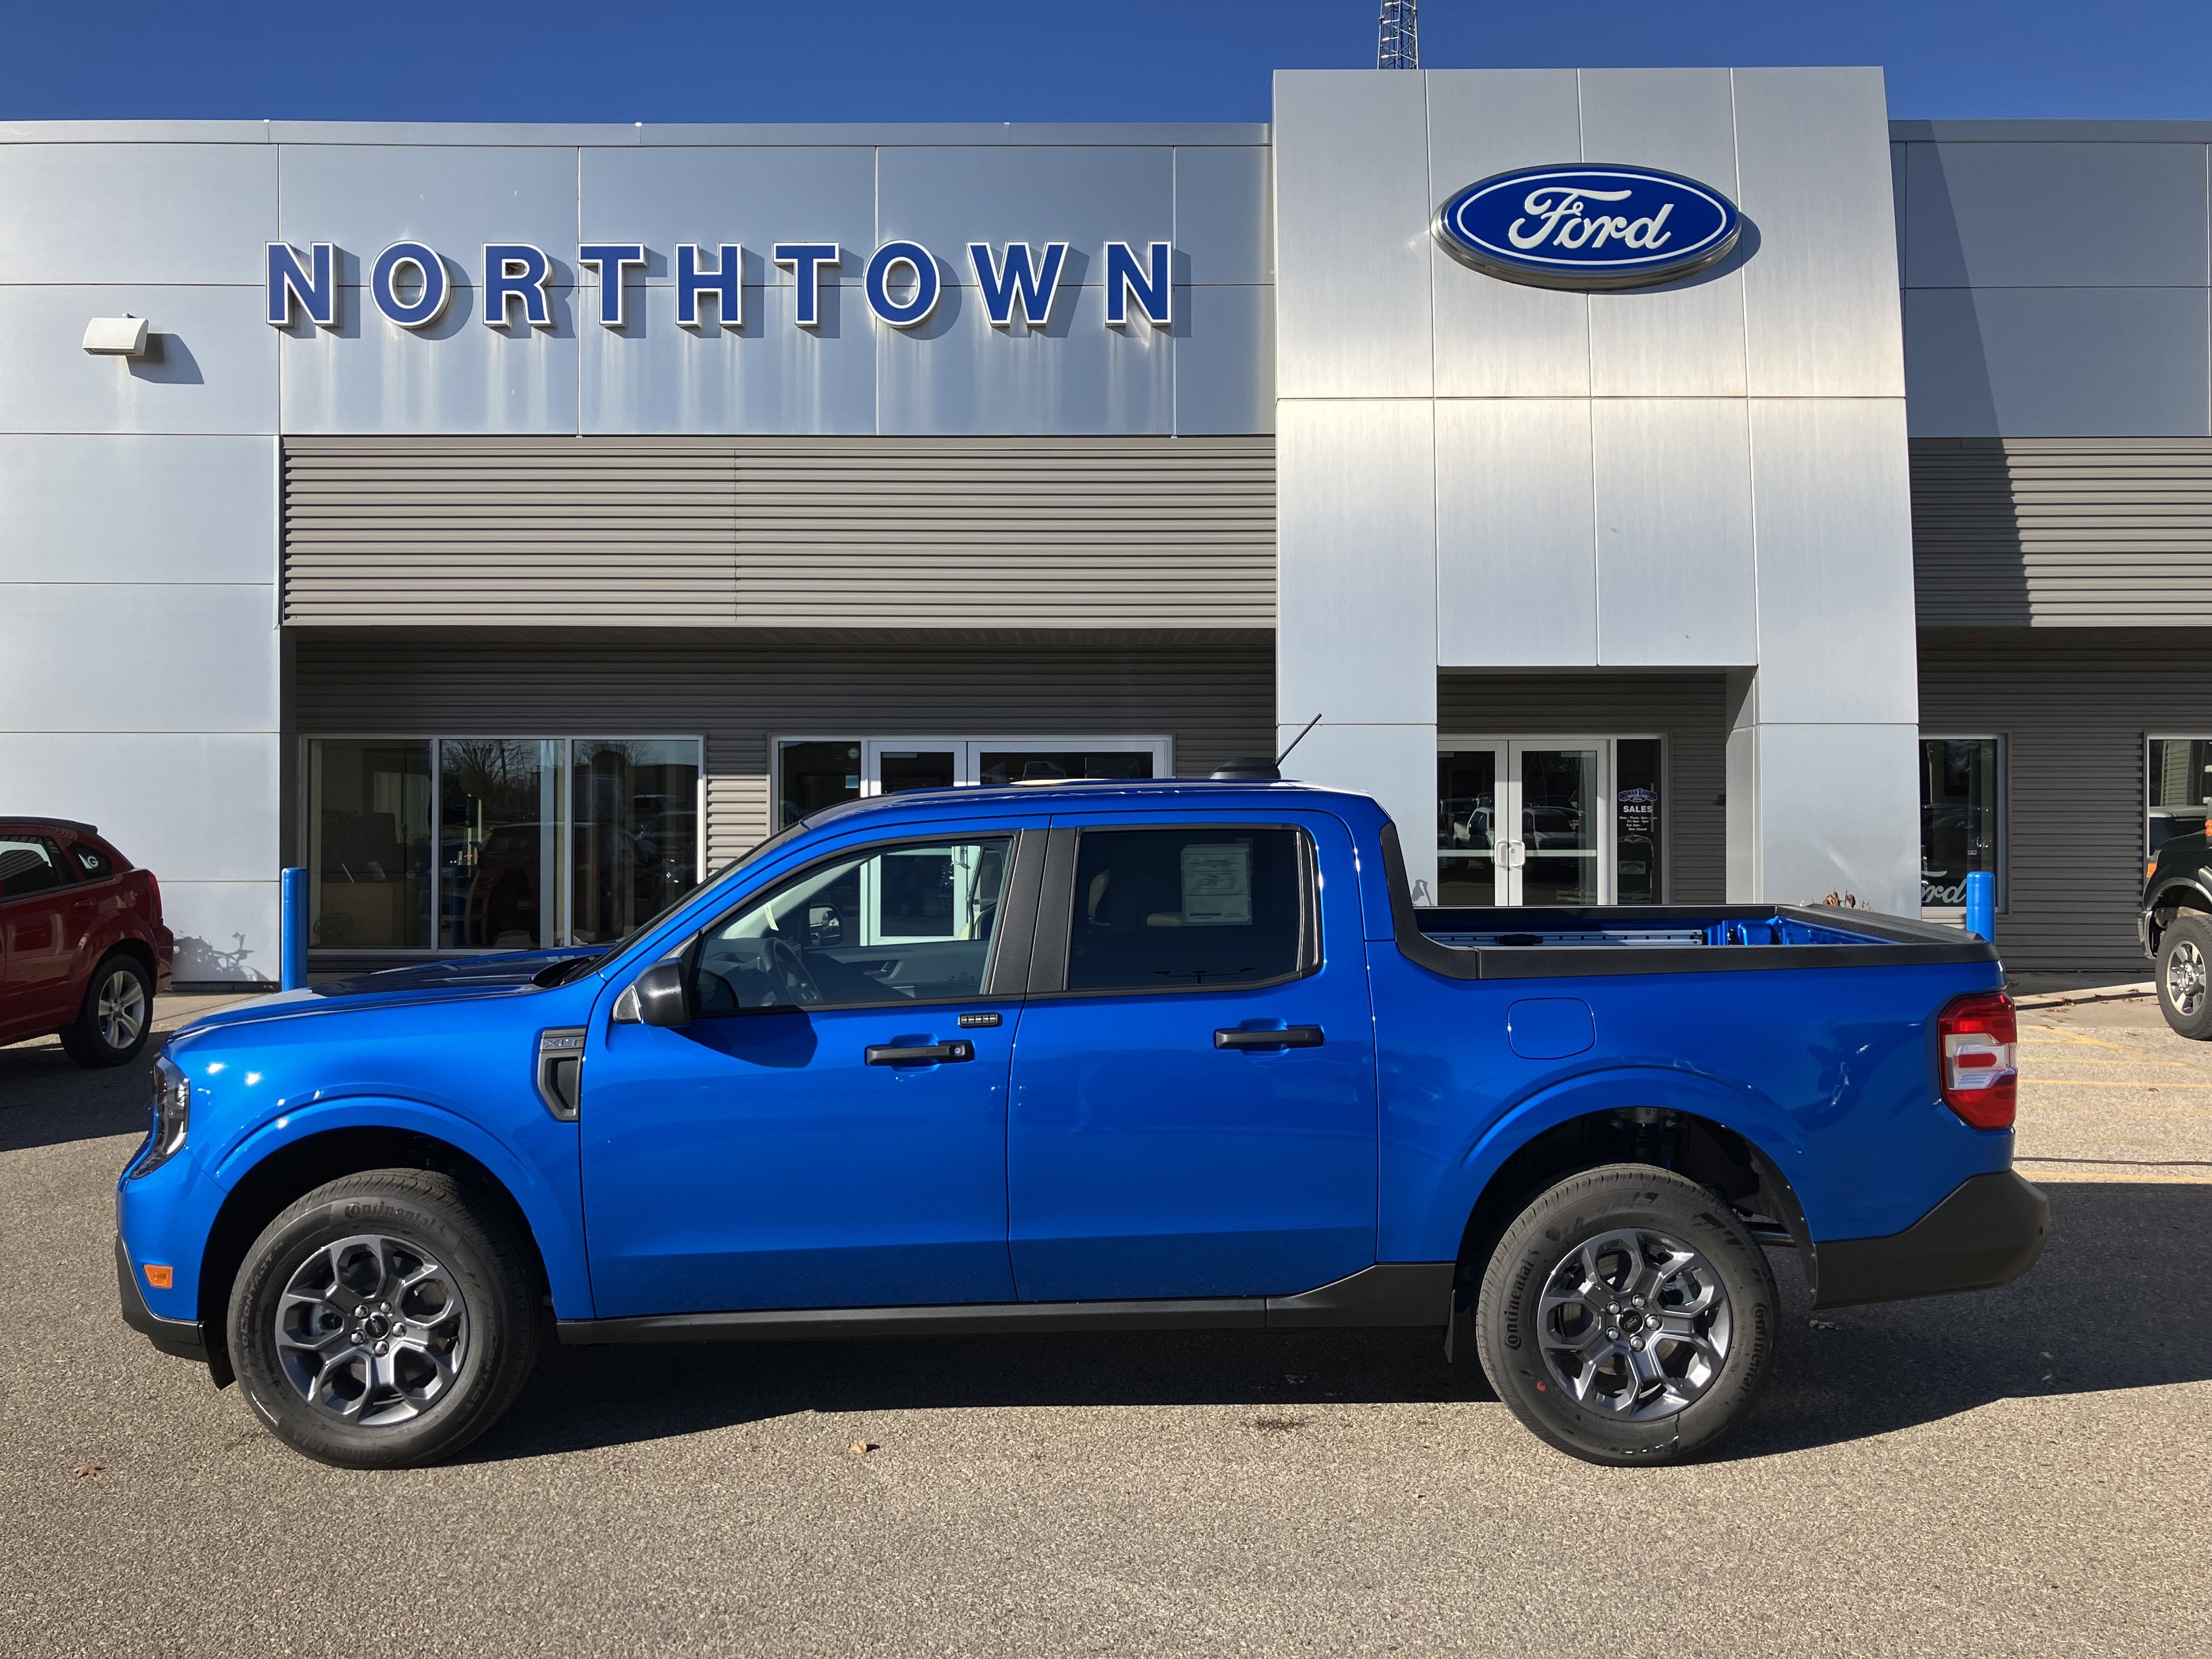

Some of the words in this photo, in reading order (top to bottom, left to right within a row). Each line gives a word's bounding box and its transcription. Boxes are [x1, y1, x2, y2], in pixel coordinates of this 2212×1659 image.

[1508, 187, 1674, 250] Ford
[264, 239, 1173, 330] NORTHTOWN
[88, 856, 99, 867] G
[1504, 1259, 1535, 1350] Continental
